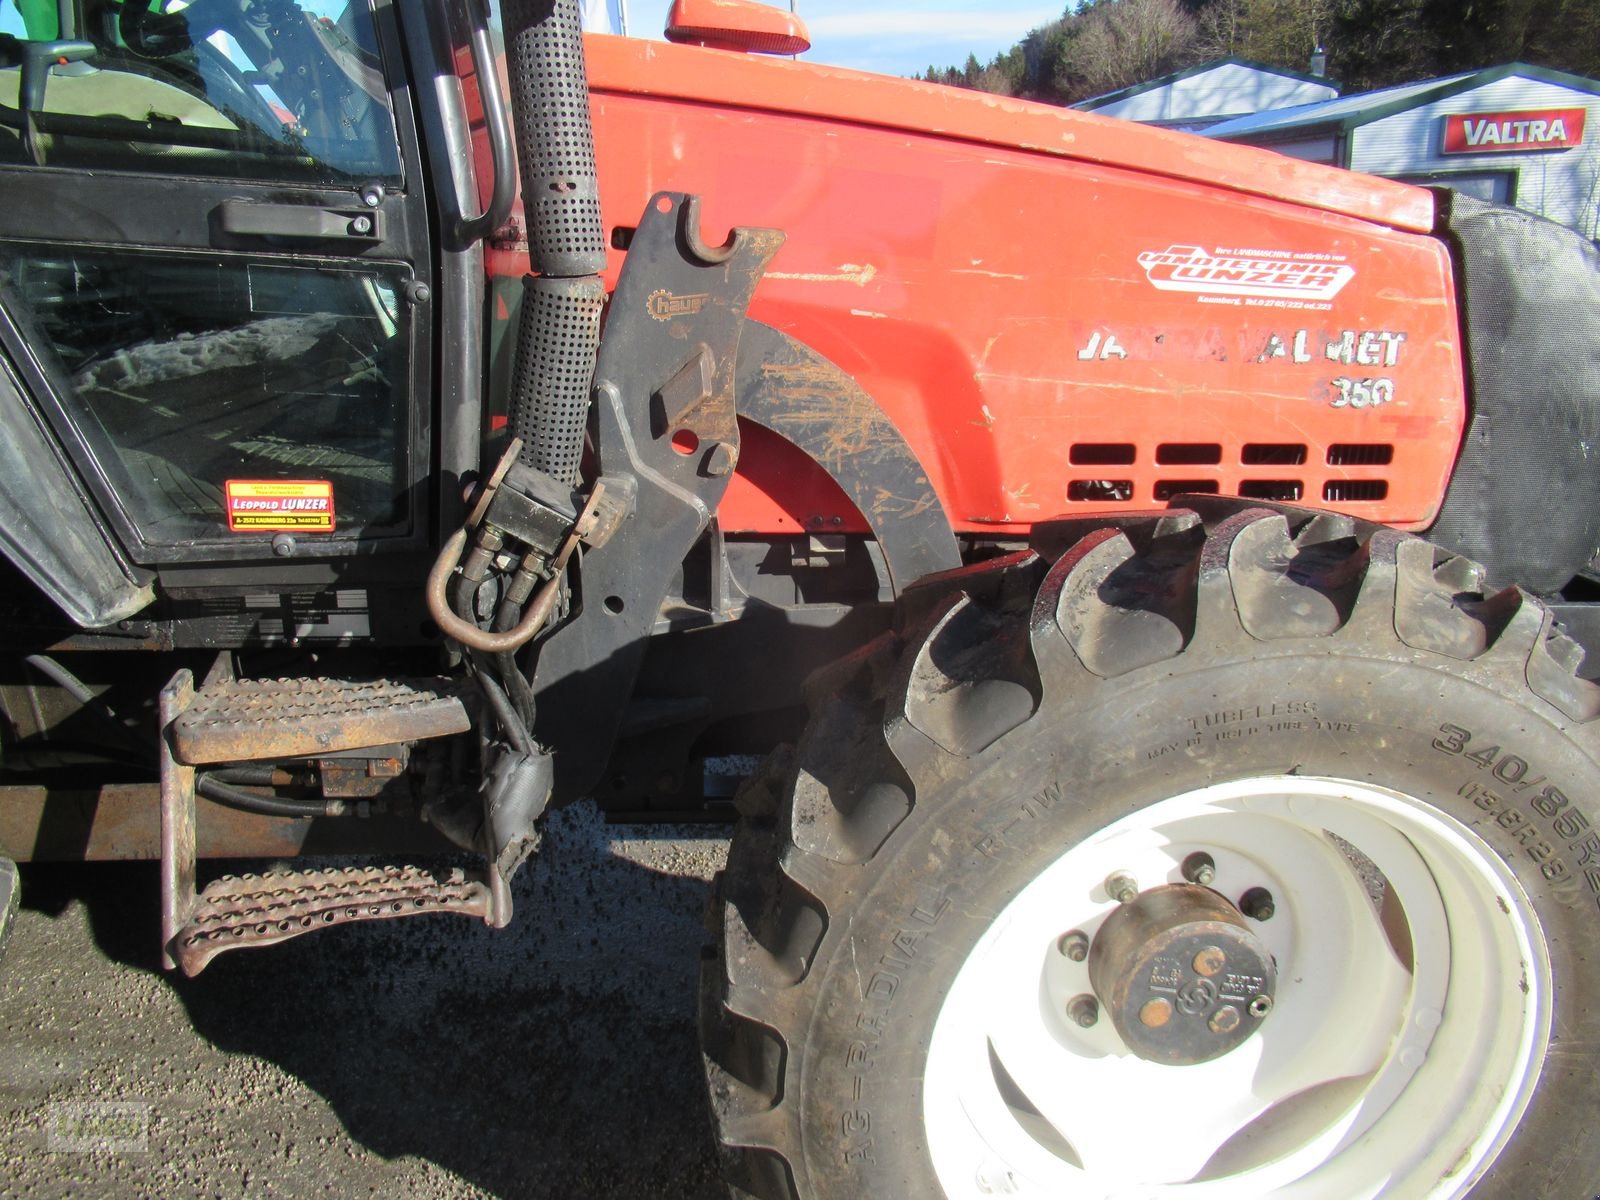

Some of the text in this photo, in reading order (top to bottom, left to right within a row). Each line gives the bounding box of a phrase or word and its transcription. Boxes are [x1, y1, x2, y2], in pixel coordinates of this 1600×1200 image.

[1463, 119, 1568, 146] VALTRA
[1138, 251, 1345, 275] LANDTECHNIK
[1233, 248, 1293, 260] LANDMASCHINE
[281, 498, 328, 510] LUNZER
[1187, 700, 1320, 731] TUBELESS
